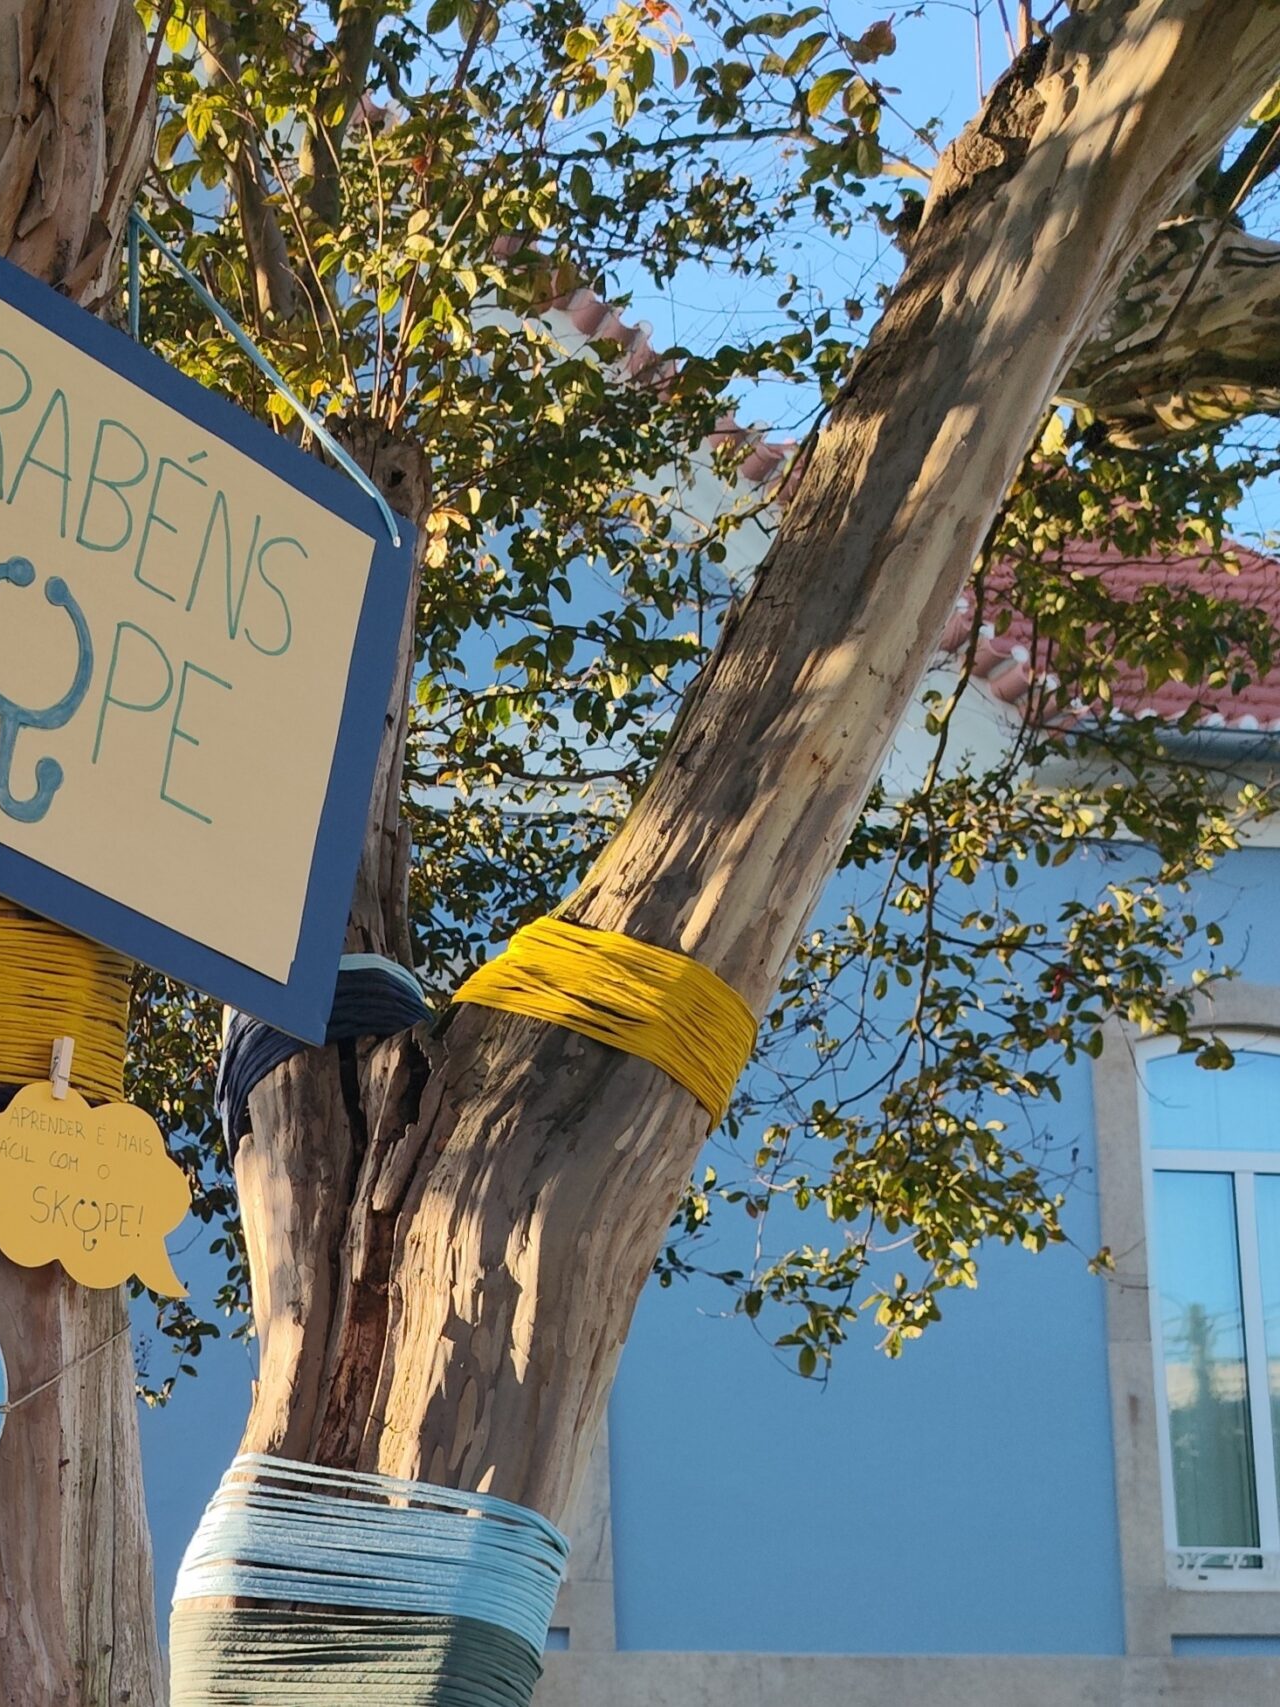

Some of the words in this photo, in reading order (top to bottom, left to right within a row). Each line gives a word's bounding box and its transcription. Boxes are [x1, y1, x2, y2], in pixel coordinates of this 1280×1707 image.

[8, 1106, 87, 1140] APRENDER
[116, 1131, 153, 1156] MAIS
[48, 1150, 80, 1172] COM
